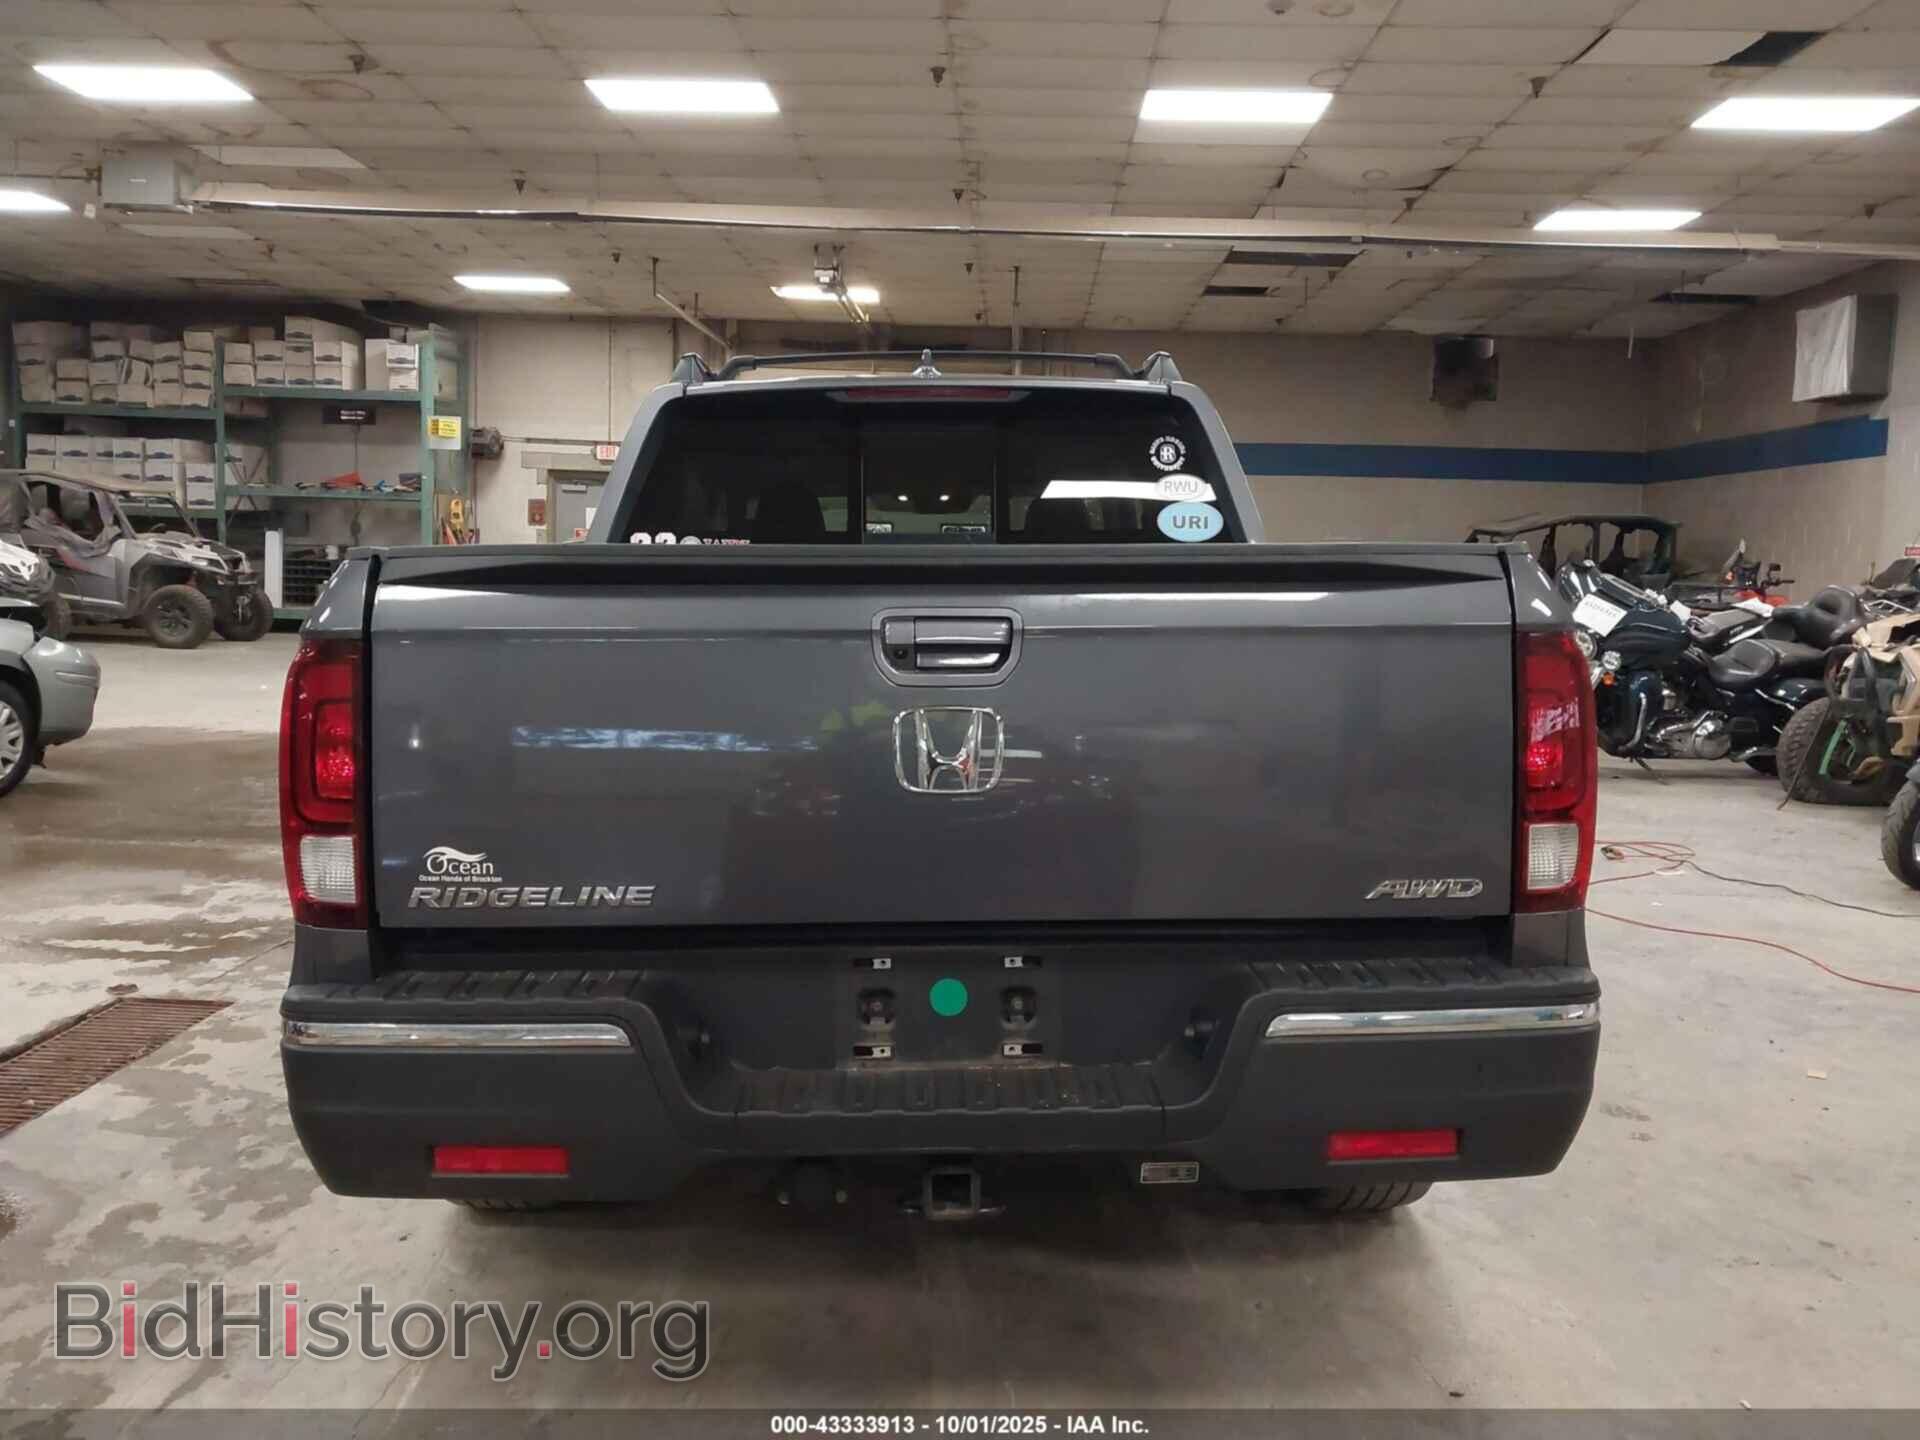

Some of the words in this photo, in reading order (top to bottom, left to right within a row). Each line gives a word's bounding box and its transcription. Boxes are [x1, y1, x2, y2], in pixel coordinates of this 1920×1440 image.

[1164, 480, 1198, 493] RWU
[1173, 516, 1208, 529] URI
[427, 854, 494, 875] Ocean
[408, 885, 656, 908] RIDGELINE
[1365, 879, 1483, 899] AWD
